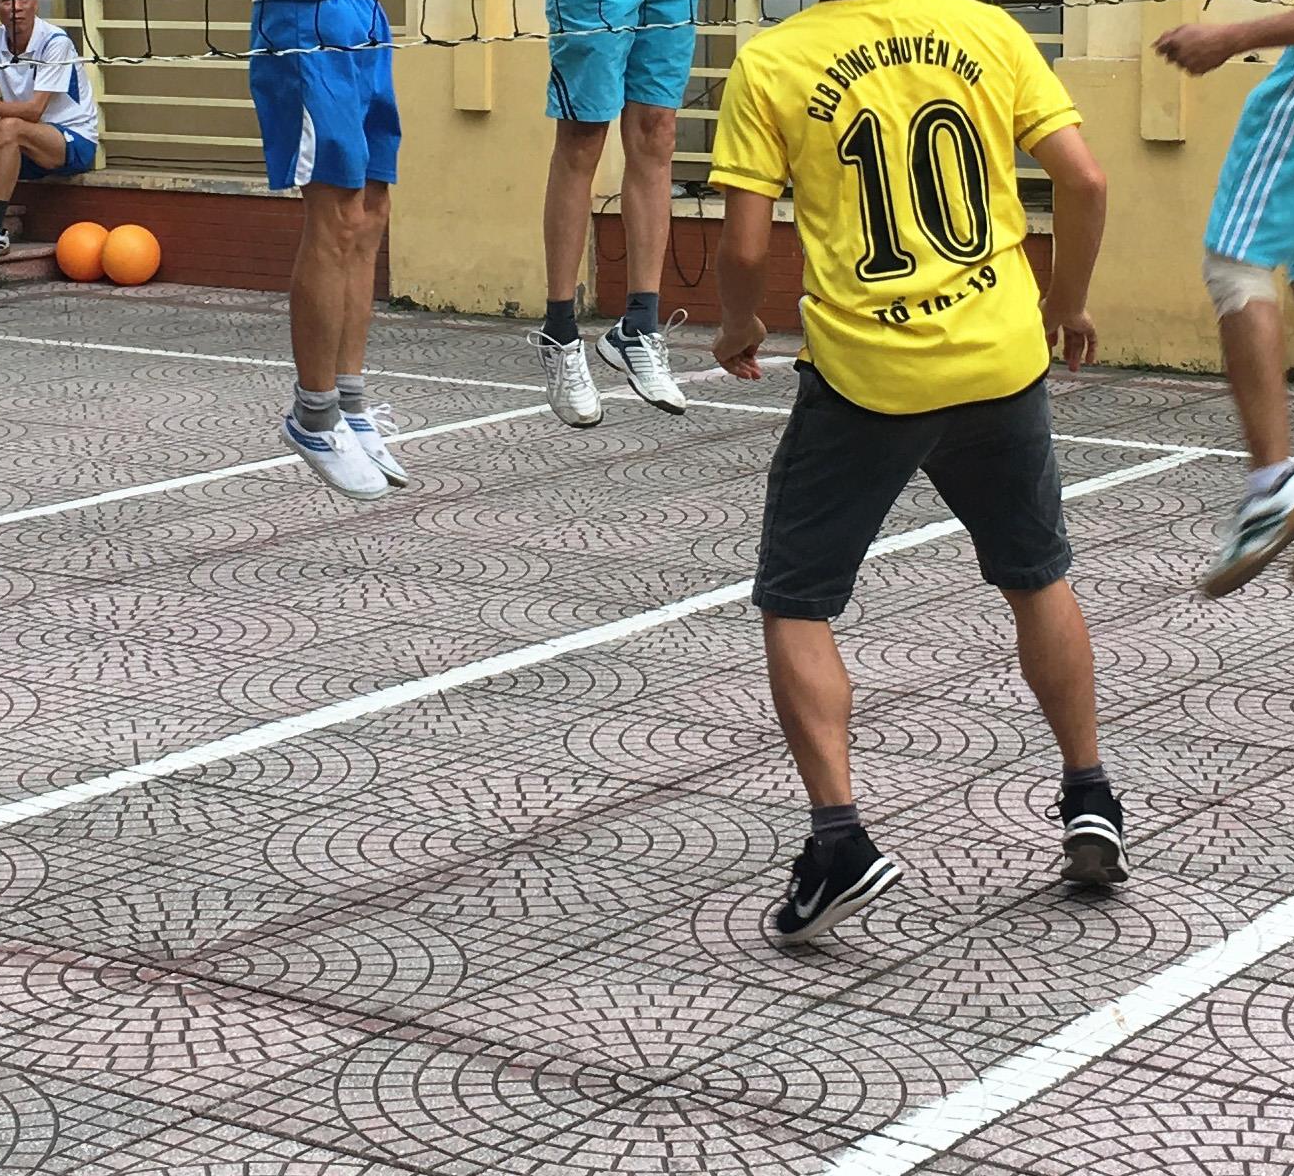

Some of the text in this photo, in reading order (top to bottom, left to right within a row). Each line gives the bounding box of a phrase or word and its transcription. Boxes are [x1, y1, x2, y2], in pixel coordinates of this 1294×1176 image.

[807, 30, 984, 123] CLB BÓNG CHUYỂN HƠI
[837, 98, 994, 283] 10
[872, 296, 911, 326] TỔ
